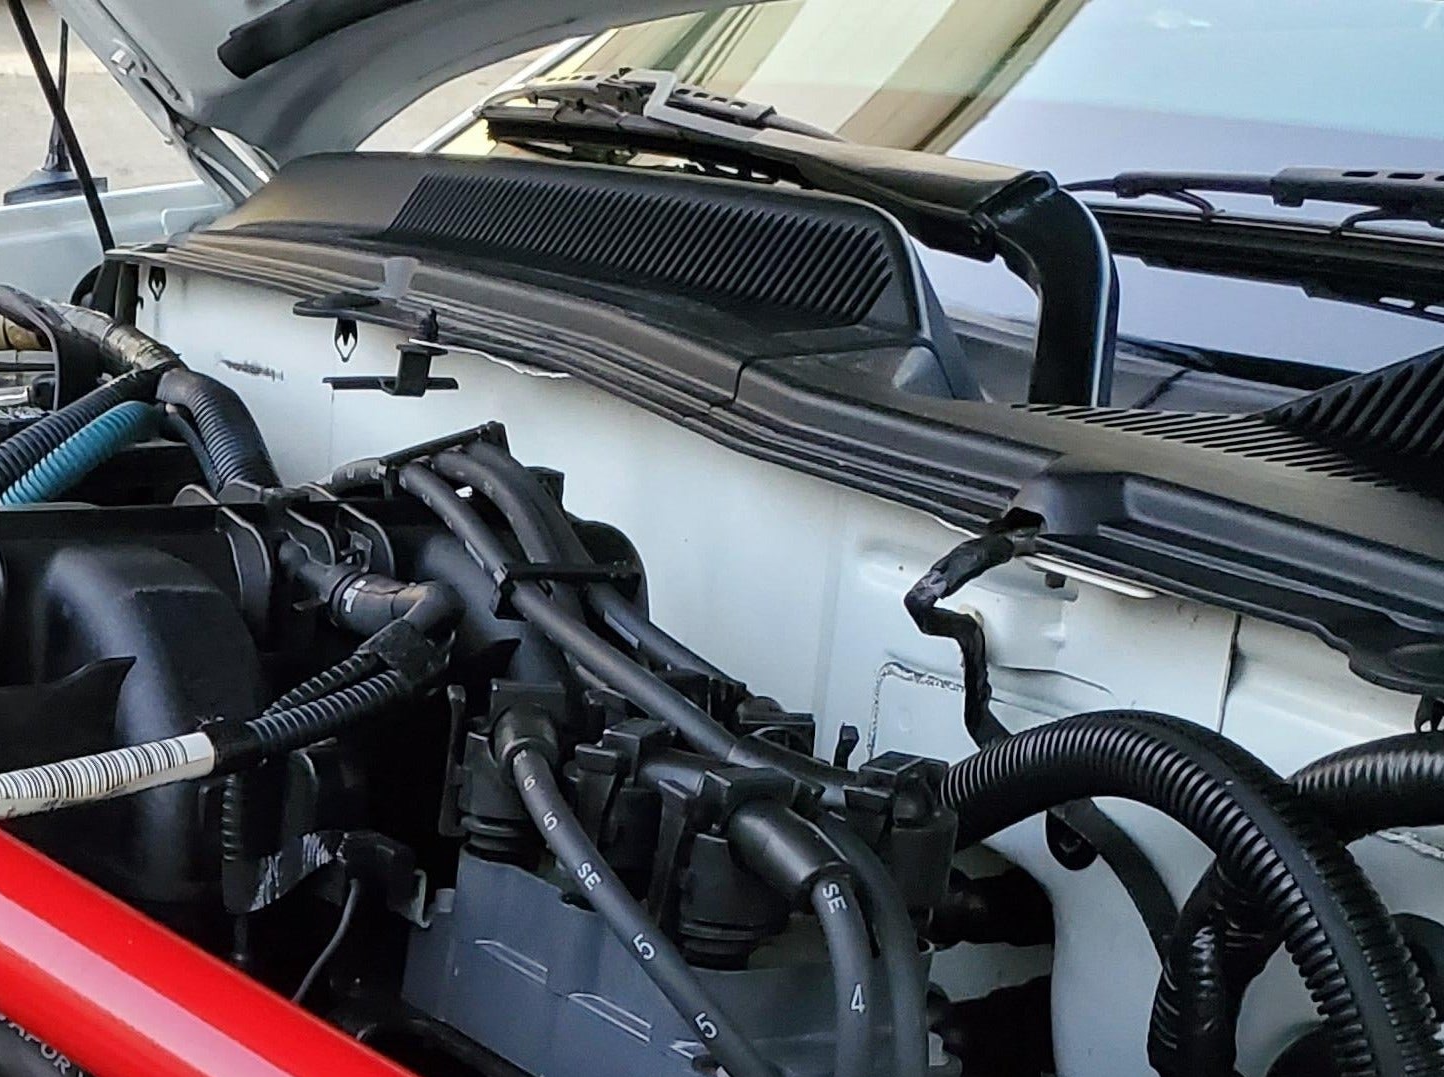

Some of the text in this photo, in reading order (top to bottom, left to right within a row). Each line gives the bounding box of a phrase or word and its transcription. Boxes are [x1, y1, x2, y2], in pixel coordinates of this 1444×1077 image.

[543, 811, 558, 831] 5
[577, 862, 602, 891] SE
[822, 883, 848, 914] SE
[632, 933, 655, 960] 5
[850, 983, 865, 1014] 4
[695, 1012, 718, 1039] 5
